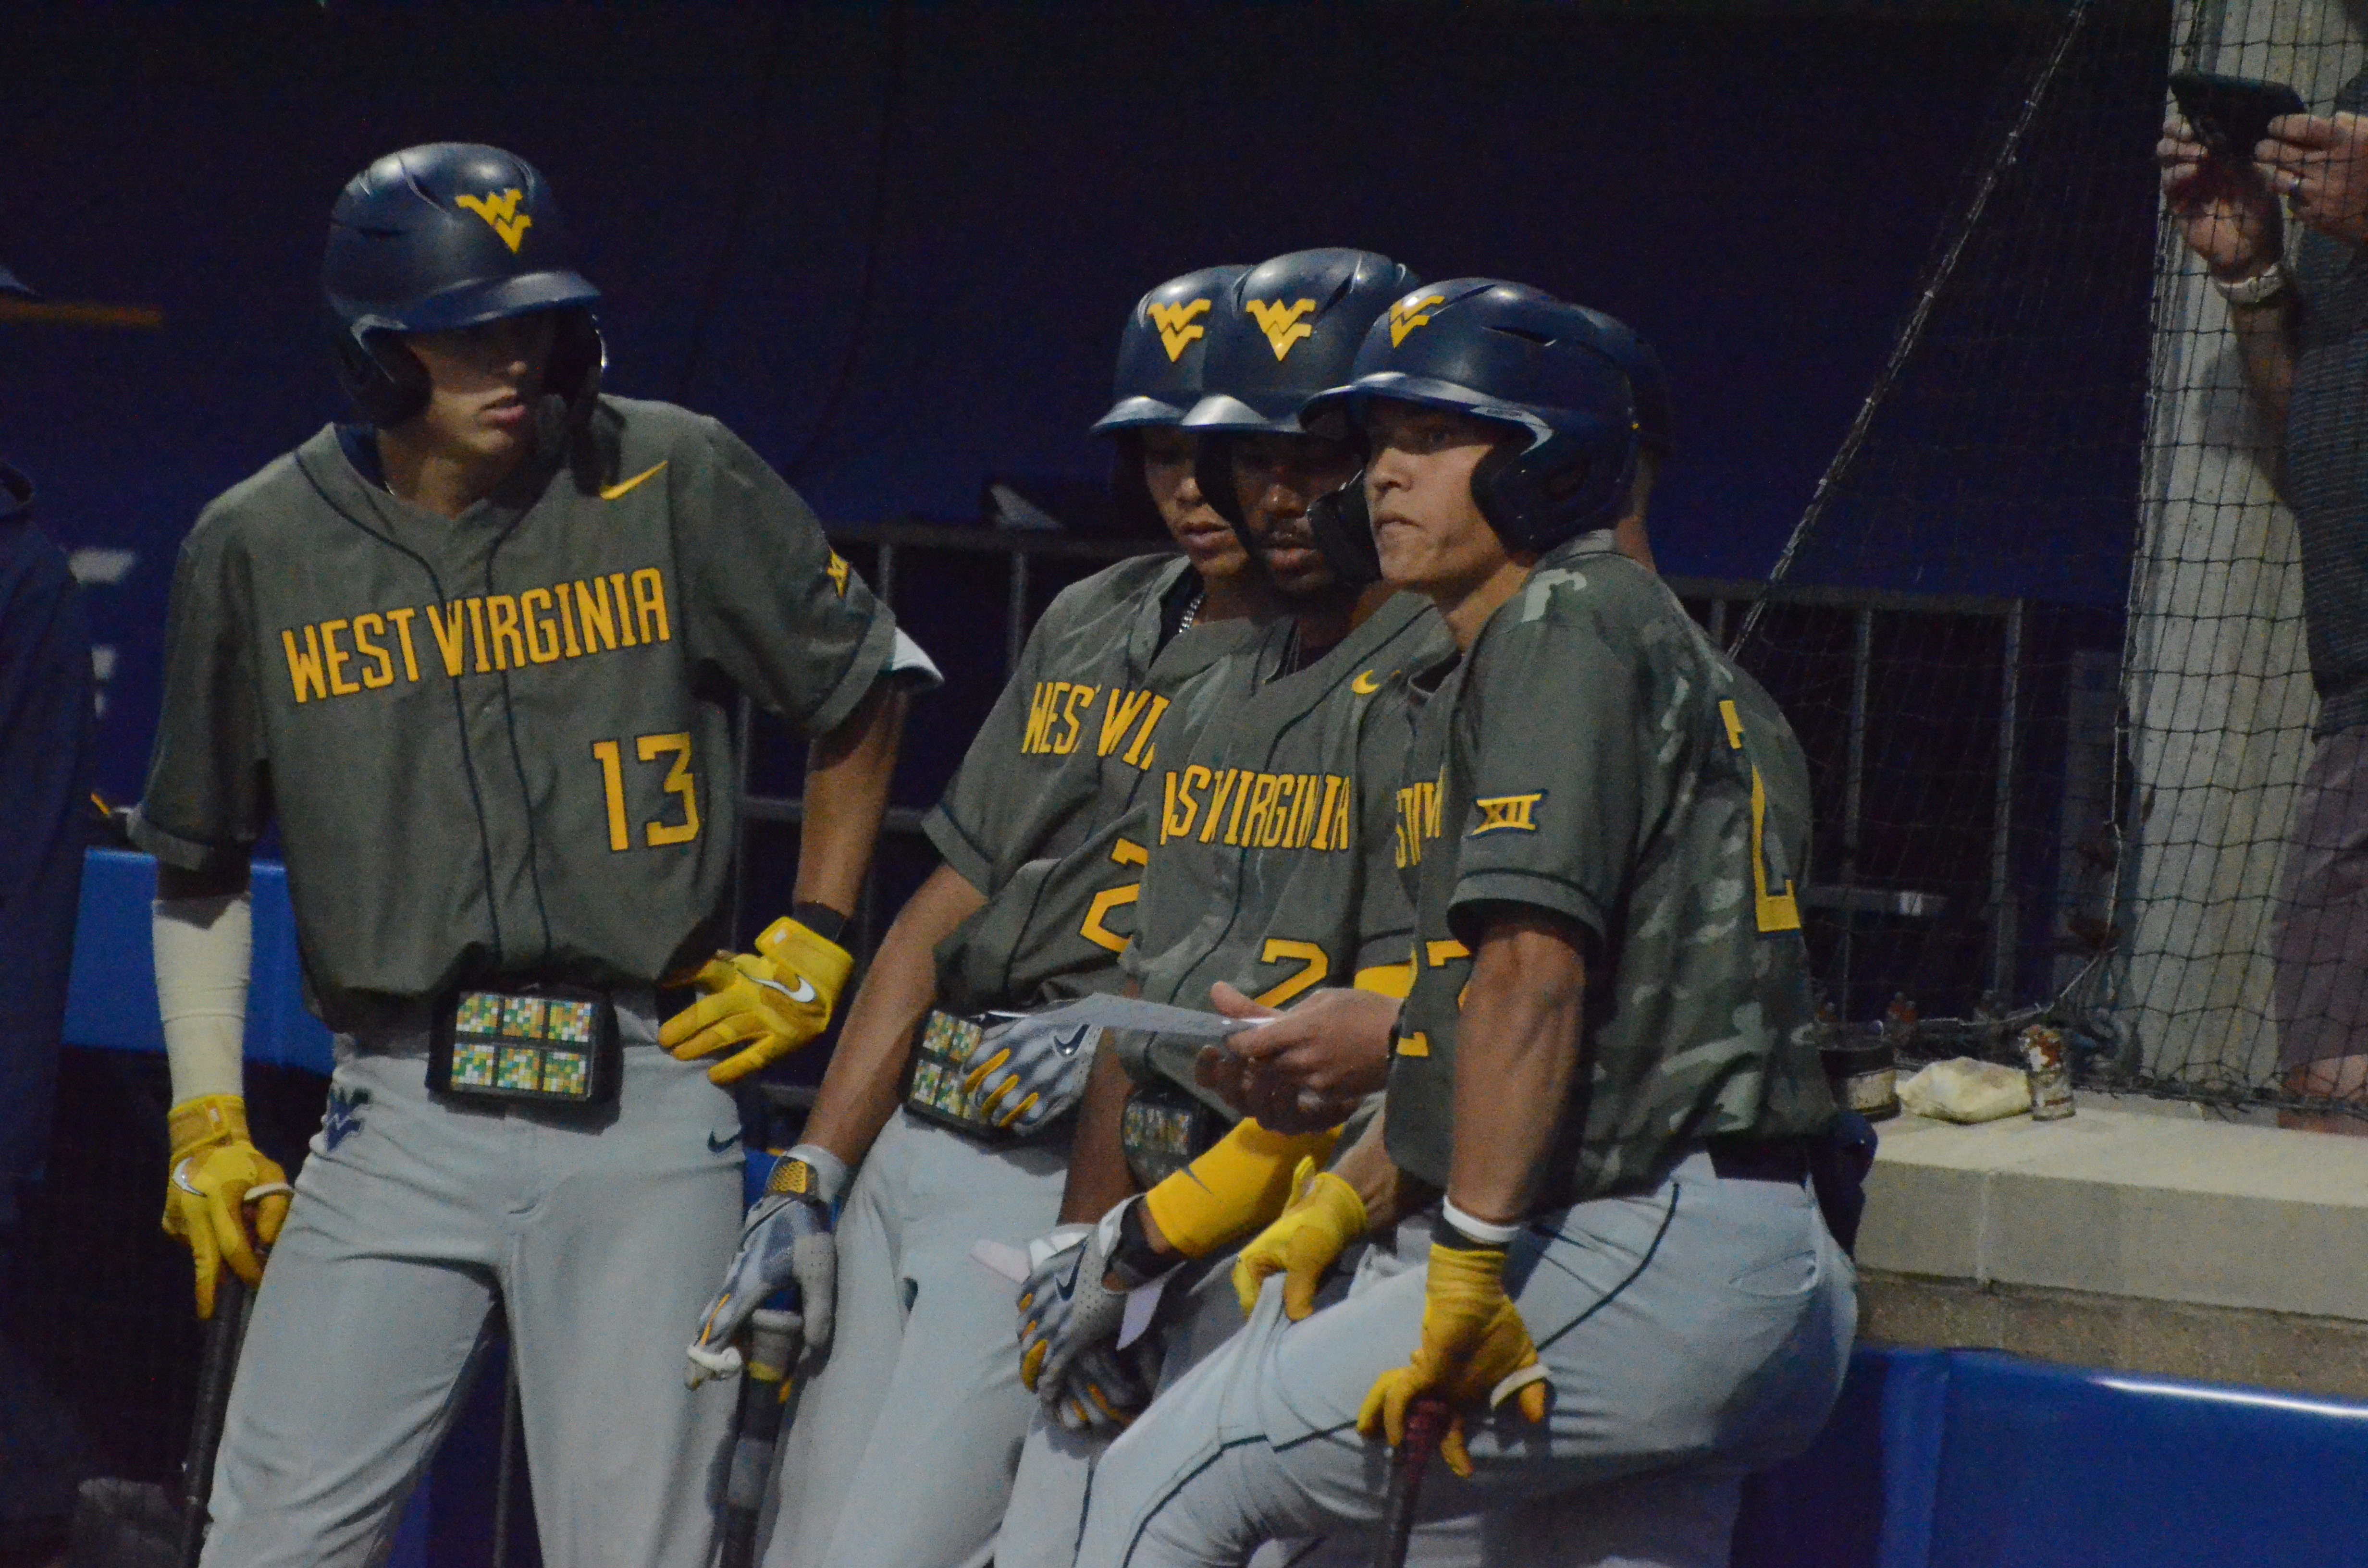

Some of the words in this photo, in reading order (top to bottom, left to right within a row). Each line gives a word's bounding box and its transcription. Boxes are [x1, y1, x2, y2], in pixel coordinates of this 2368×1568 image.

[282, 607, 420, 704] WEST
[426, 567, 671, 678] VIRGINIA
[1020, 681, 1102, 756] WES
[592, 732, 701, 852] 13
